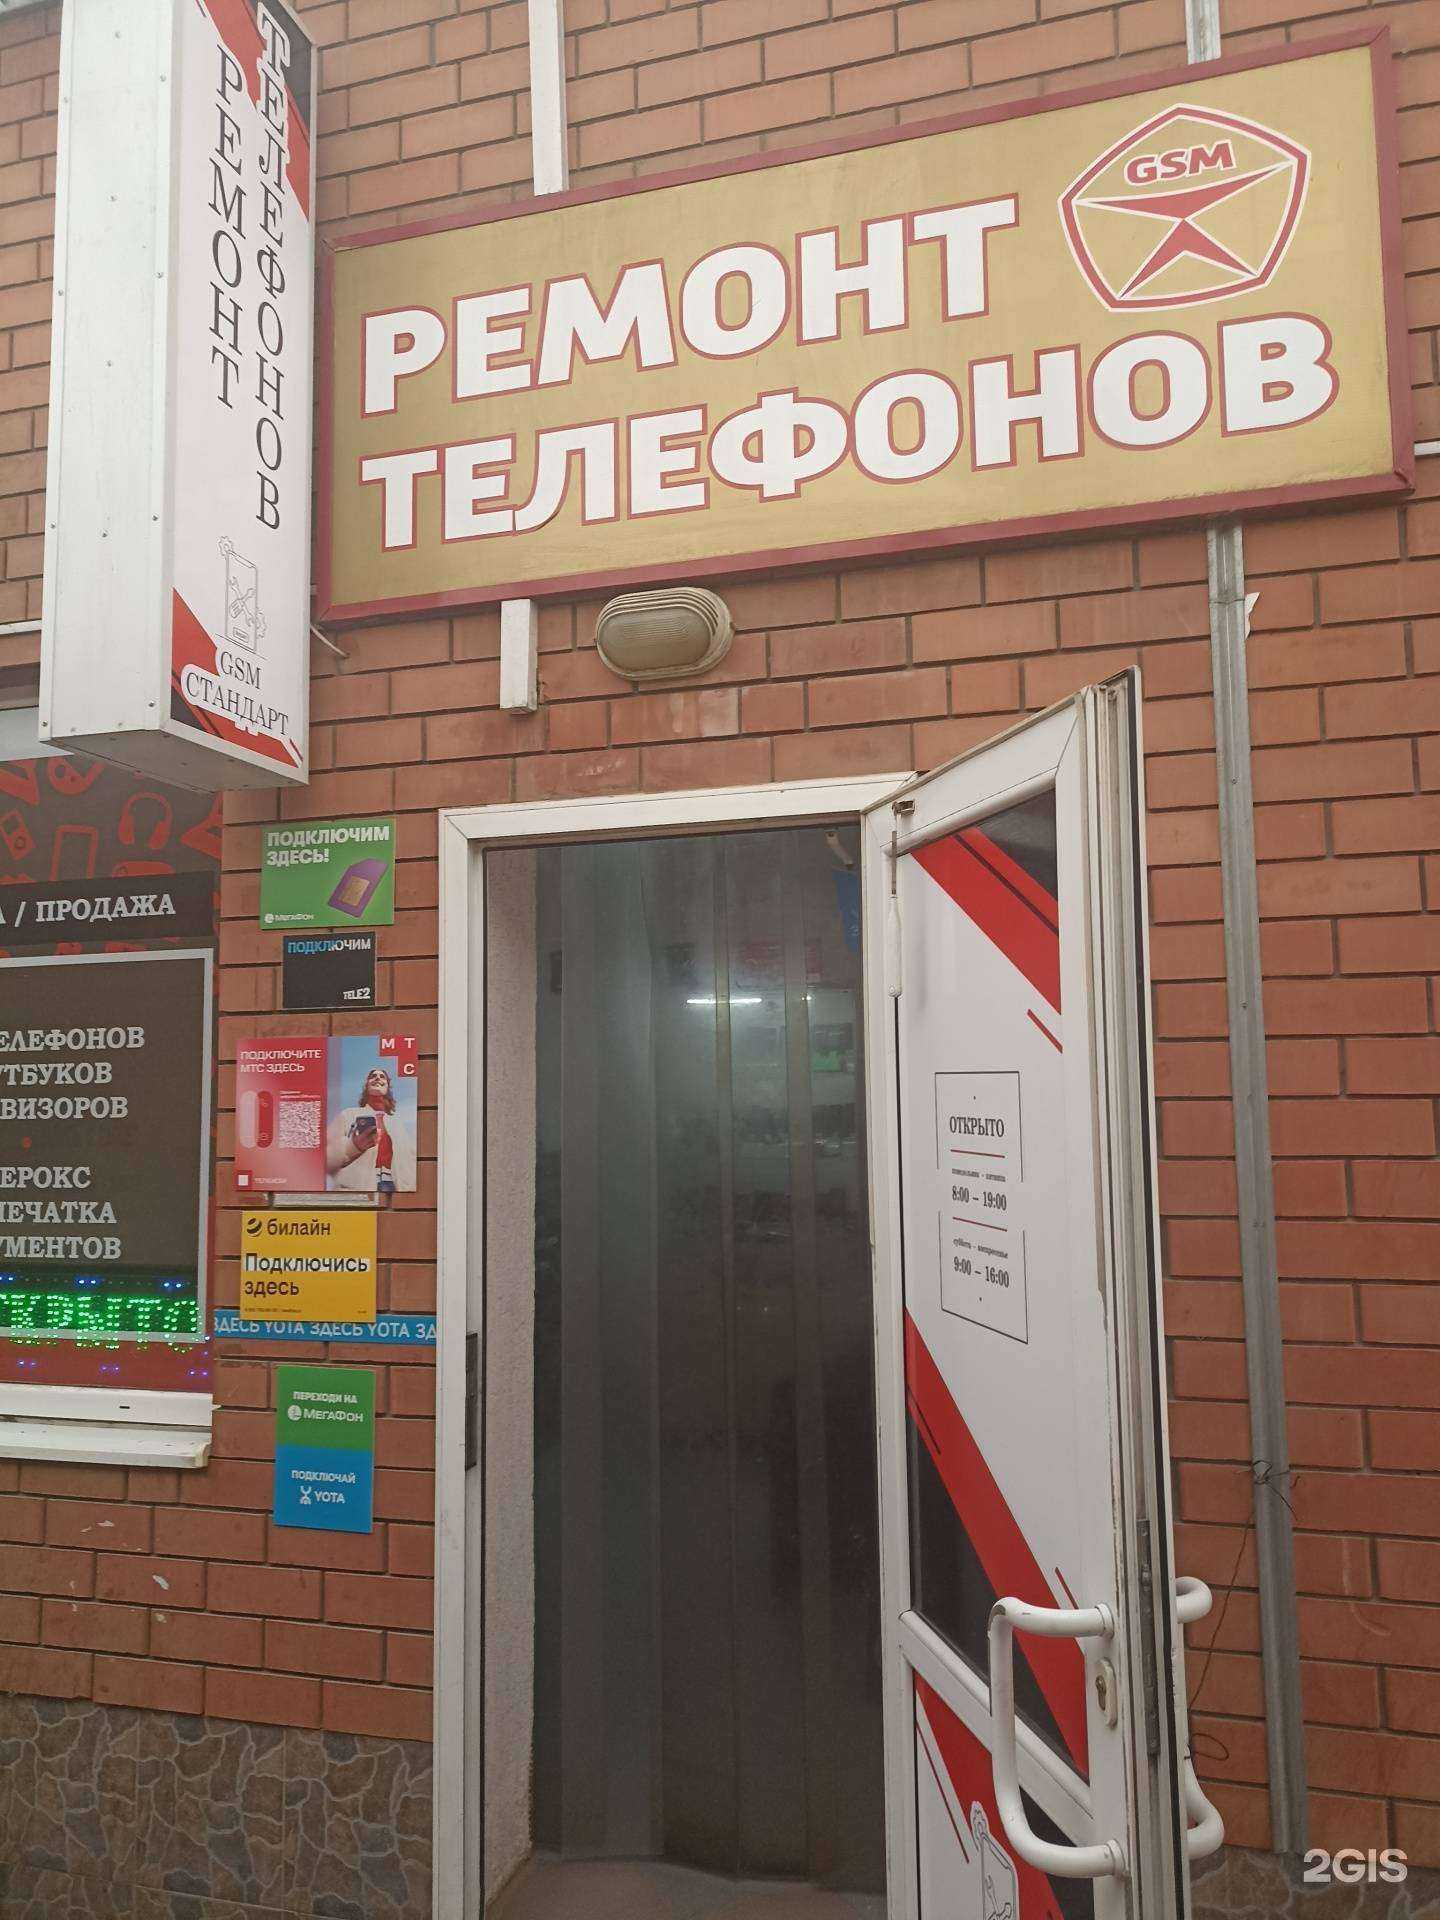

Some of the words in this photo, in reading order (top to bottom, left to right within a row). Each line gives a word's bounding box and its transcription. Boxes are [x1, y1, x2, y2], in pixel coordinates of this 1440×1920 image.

[1124, 140, 1236, 185] GSM
[208, 44, 246, 409] РЕМОНТ
[256, 12, 287, 530] ТЕЛЕФОНОВ
[361, 193, 1018, 417] РЕМОНТ
[359, 311, 1339, 552] ТЕЛЕФОНОВ
[220, 652, 262, 689] GSM
[186, 672, 289, 735] СТАНДАРТ
[267, 826, 390, 847] ПОДКЛЮЧИМ
[266, 848, 330, 867] ЗДЕСЬ!
[36, 894, 176, 922] ПРОДАЖА
[287, 938, 371, 954] ПОДКЛЮЧИМ
[343, 988, 371, 1000] TELE2
[240, 1049, 322, 1060] ПОДКЛЮЧИТЕ
[240, 1063, 265, 1073] МТС
[266, 1063, 305, 1073] ЗДЕСЬ
[0, 1096, 128, 1120] ВИЗОРОВ
[950, 1116, 1004, 1137] ОТКРЫТО
[0, 1166, 91, 1189] ЕРОКС
[952, 1185, 970, 1203] 8:00
[983, 1191, 1007, 1211] 19:00
[267, 1218, 331, 1236] билайн
[245, 1252, 369, 1275] Подключись
[954, 1256, 971, 1275] 9:00
[985, 1266, 1009, 1288] 16:00
[244, 1281, 300, 1298] здесь
[265, 1321, 305, 1335] YOTA
[310, 1323, 363, 1337] ЗДЕСЬ
[368, 1322, 410, 1338] YOTA
[293, 1391, 342, 1404] ПЕРЕХОДИ
[344, 1395, 358, 1404] НА
[291, 1470, 356, 1483] ПОДКЛЮЧАЙ
[314, 1490, 345, 1504] YOTA
